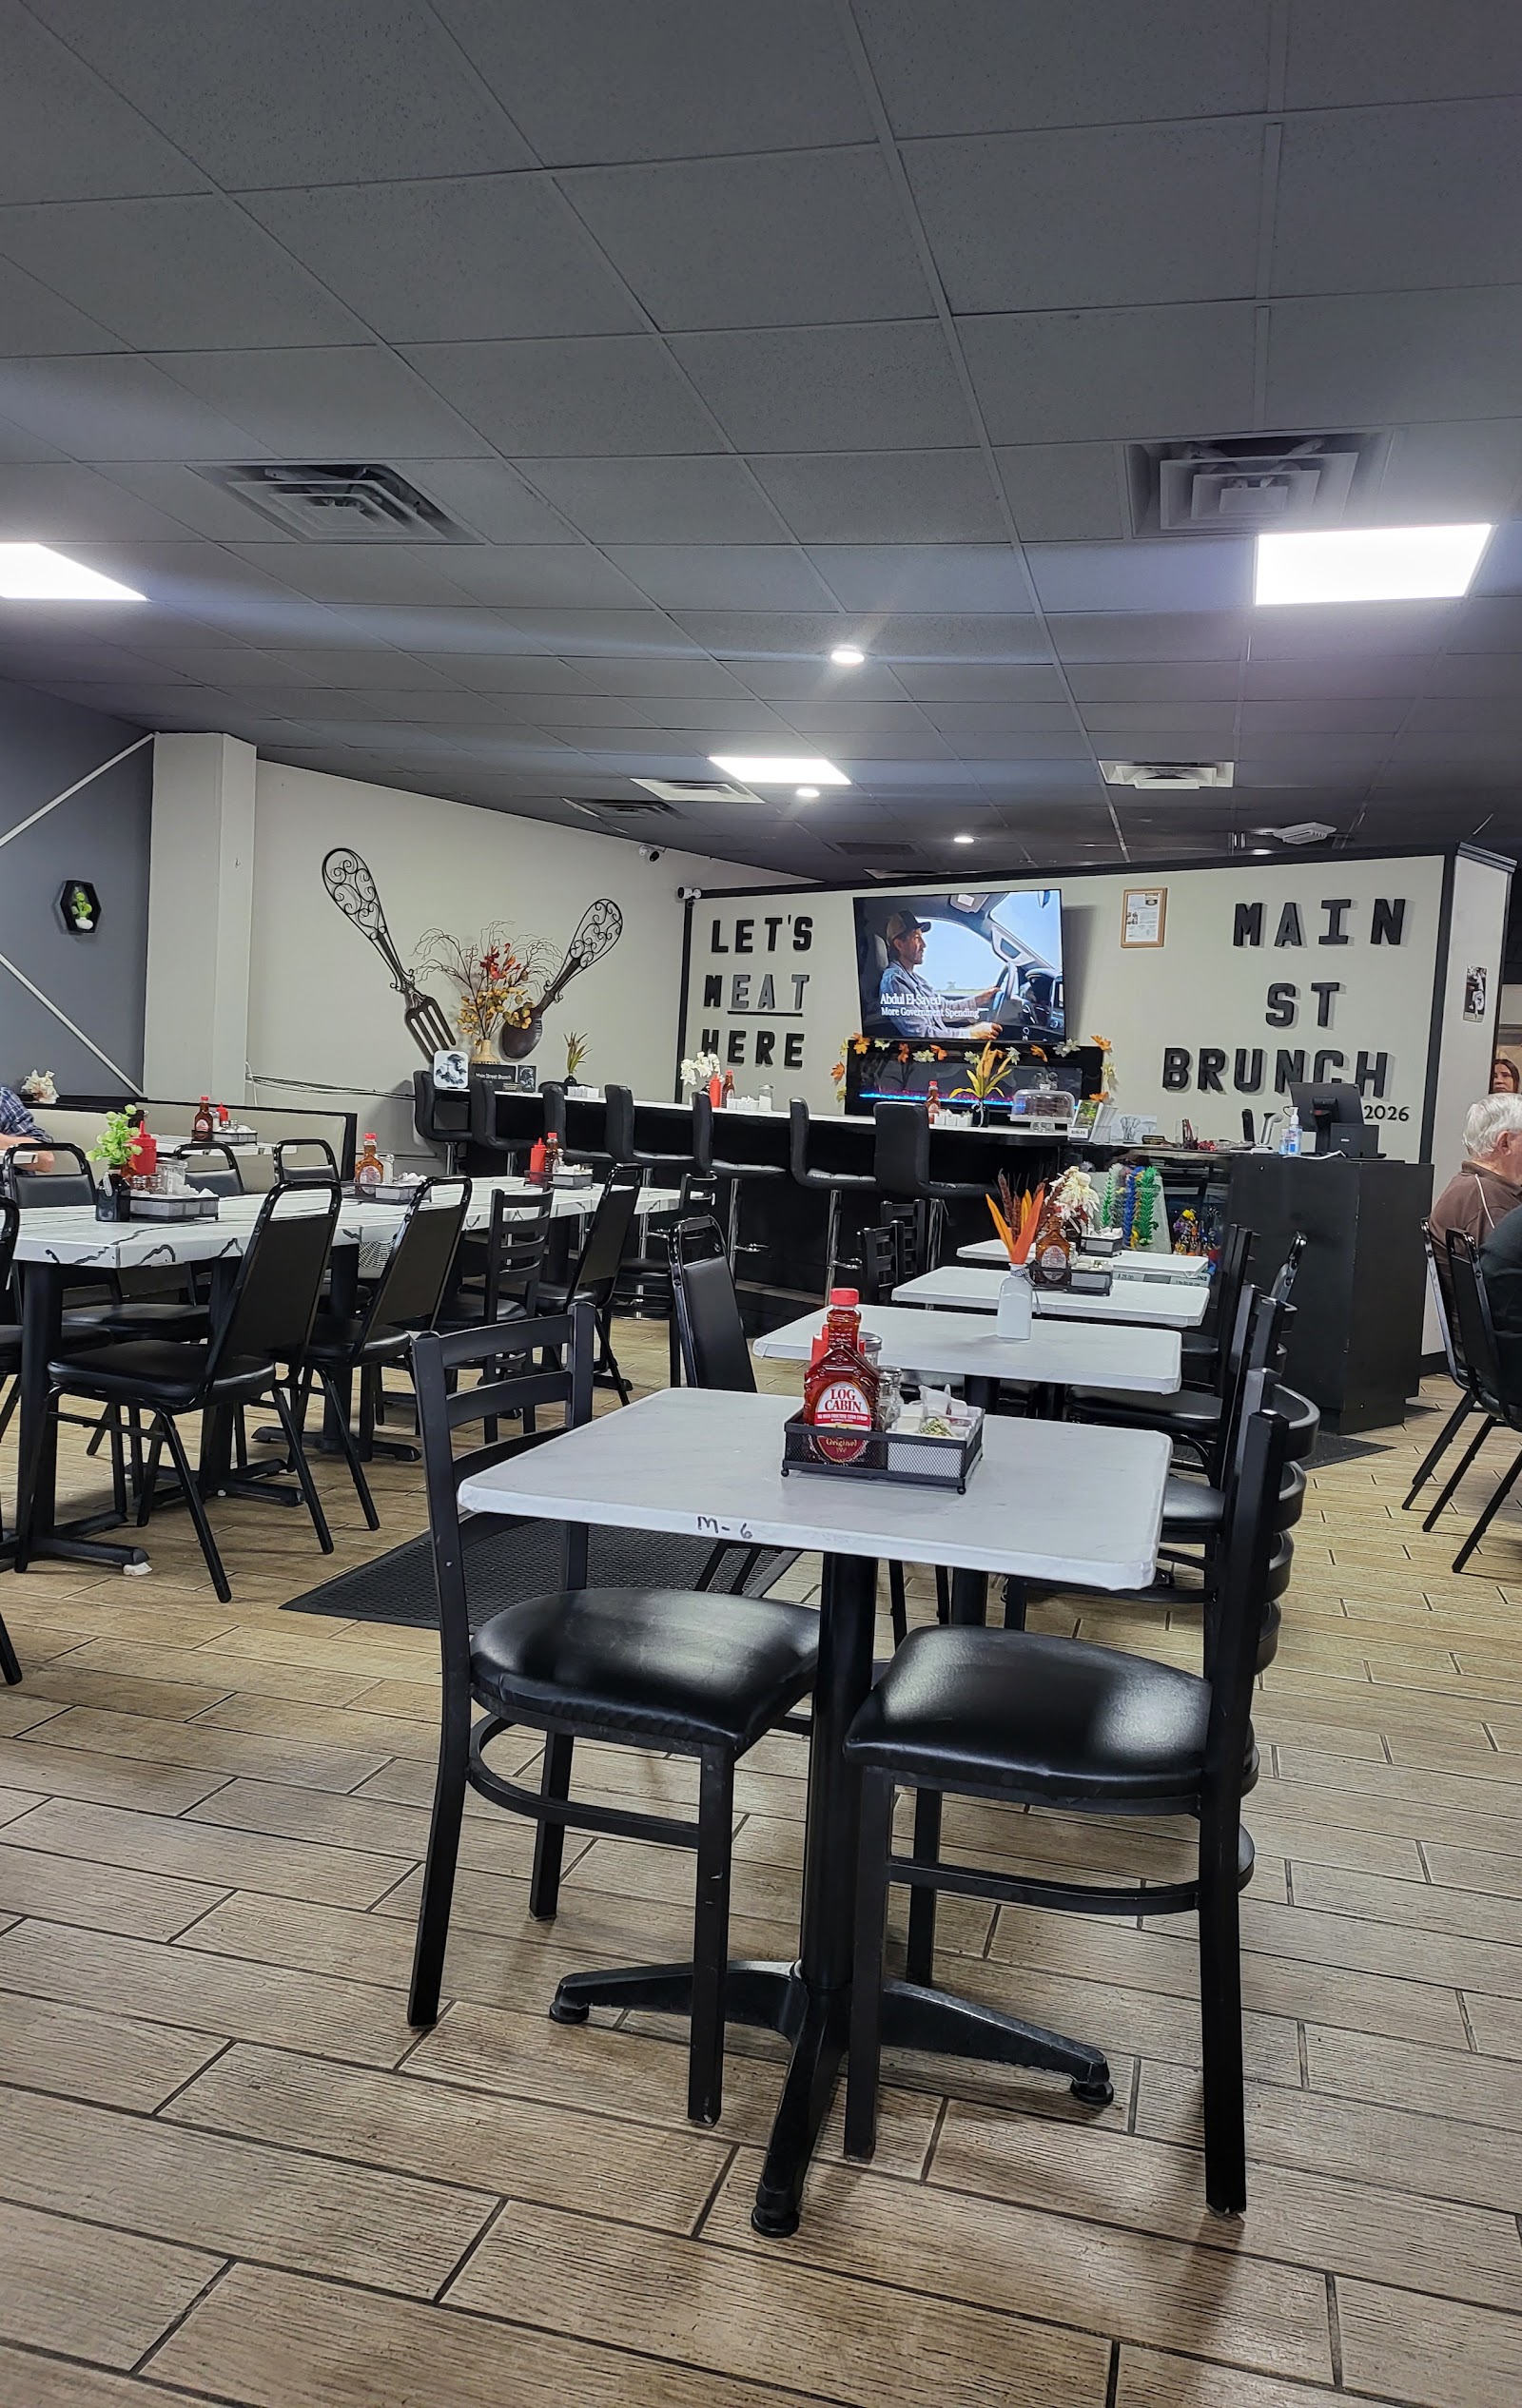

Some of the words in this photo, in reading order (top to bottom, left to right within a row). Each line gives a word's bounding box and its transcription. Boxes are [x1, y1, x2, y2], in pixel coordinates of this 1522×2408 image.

[712, 914, 813, 953] LET'S
[1233, 898, 1406, 947] MAIN
[703, 973, 810, 1011] MEAT
[880, 993, 905, 1005] Abdul
[906, 993, 942, 1008] El-Sayed
[1265, 981, 1340, 1027] ST
[881, 1007, 900, 1017] More
[900, 1007, 944, 1017] Government
[945, 1008, 980, 1020] Spending
[700, 1028, 805, 1068] HERE
[1161, 1047, 1389, 1097] BRUNCH
[1363, 1104, 1410, 1122] 2026
[825, 1399, 862, 1412] CABIN
[830, 1388, 855, 1401] LOG
